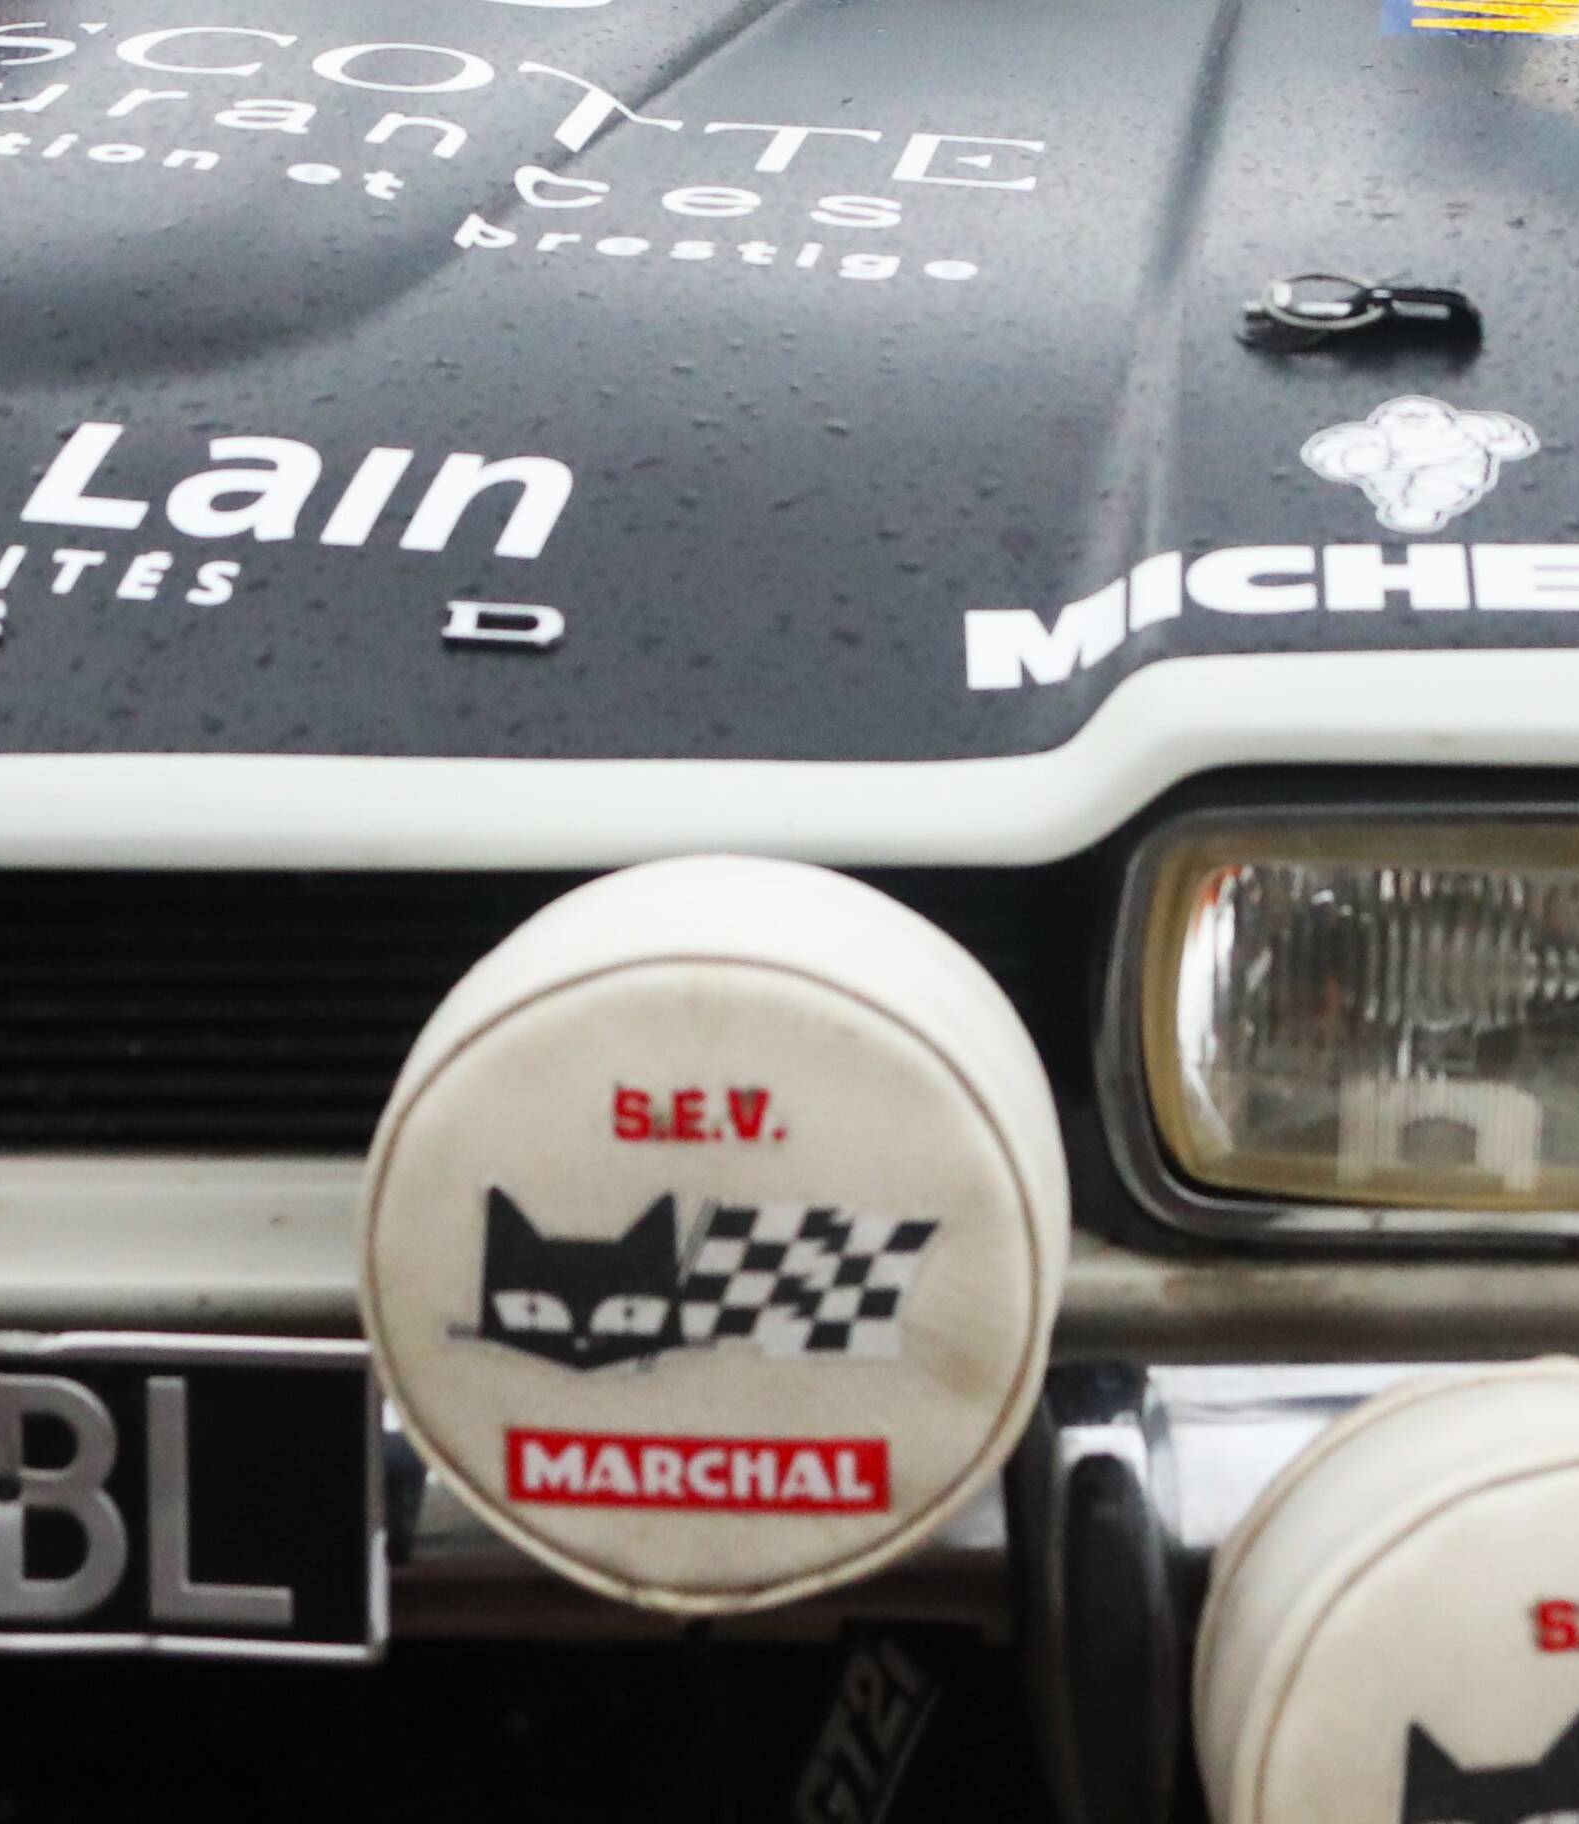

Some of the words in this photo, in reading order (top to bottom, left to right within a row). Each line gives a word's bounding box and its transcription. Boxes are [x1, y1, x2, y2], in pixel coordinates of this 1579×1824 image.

[285, 162, 405, 201] et
[20, 421, 575, 560] Lain
[612, 1086, 788, 1144] S.E.V.
[521, 1439, 874, 1501] MARCHAL
